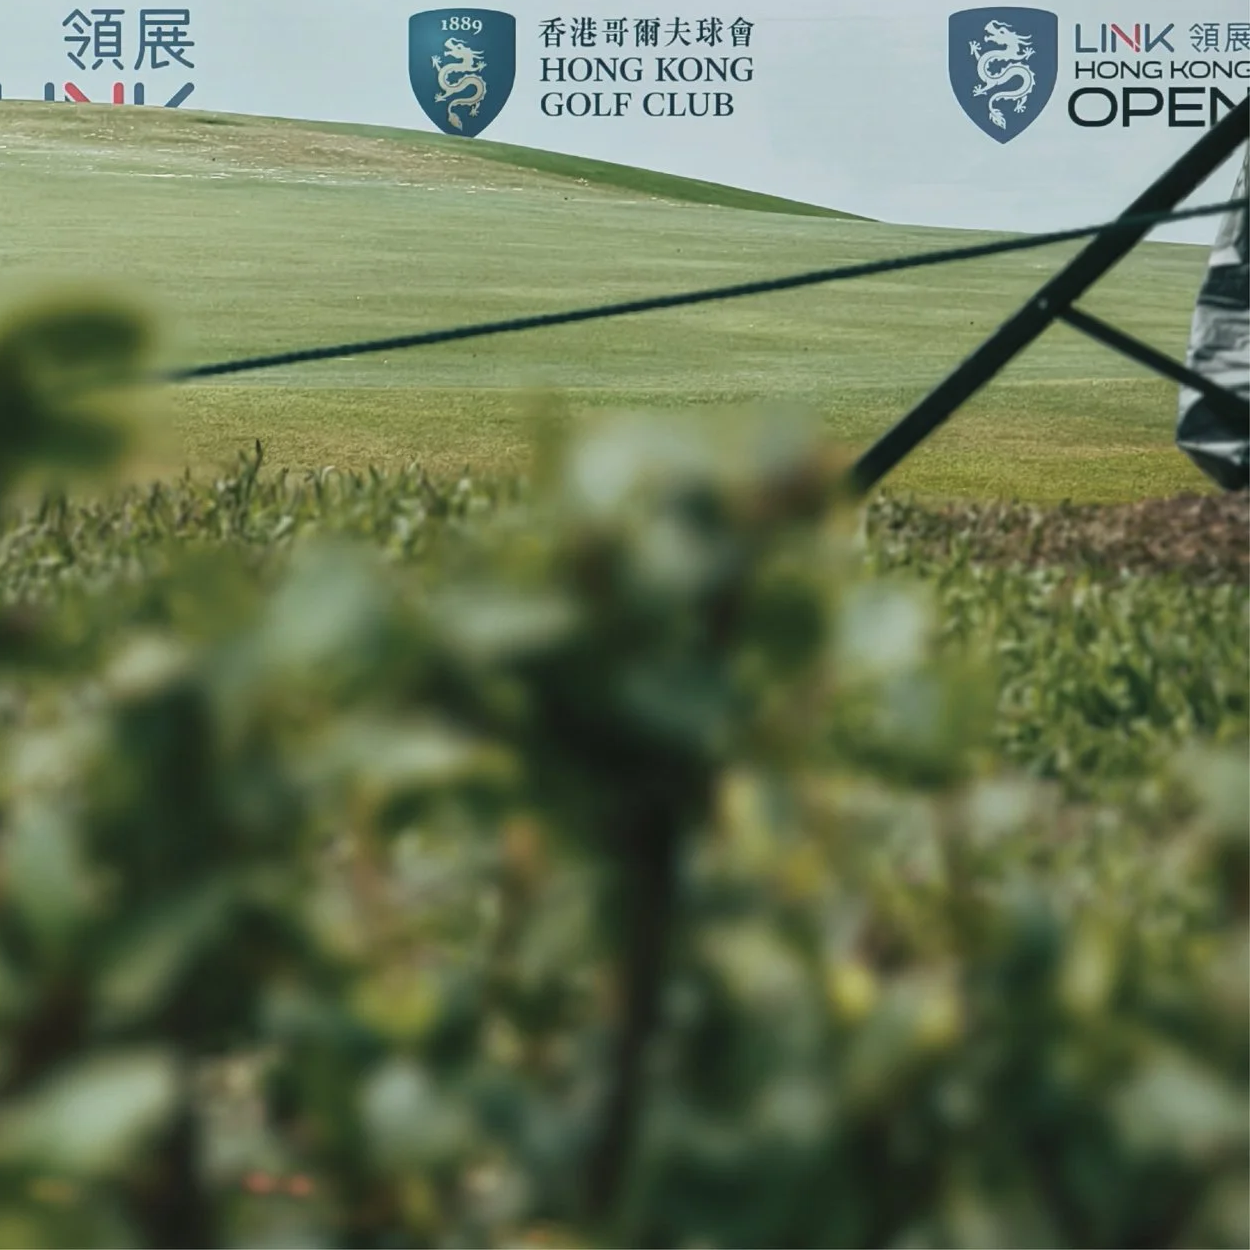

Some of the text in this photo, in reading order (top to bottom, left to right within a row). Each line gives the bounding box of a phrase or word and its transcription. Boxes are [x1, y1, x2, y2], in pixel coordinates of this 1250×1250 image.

[440, 15, 483, 35] 1889
[538, 16, 755, 48] 香港哥爾夫球會
[1075, 23, 1175, 53] LINK
[1189, 23, 1250, 53] 領展
[62, 8, 195, 71] 領展
[539, 56, 754, 83] HONG KONG
[1074, 60, 1250, 80] HONG KONG
[540, 91, 735, 118] GOLF CLUB
